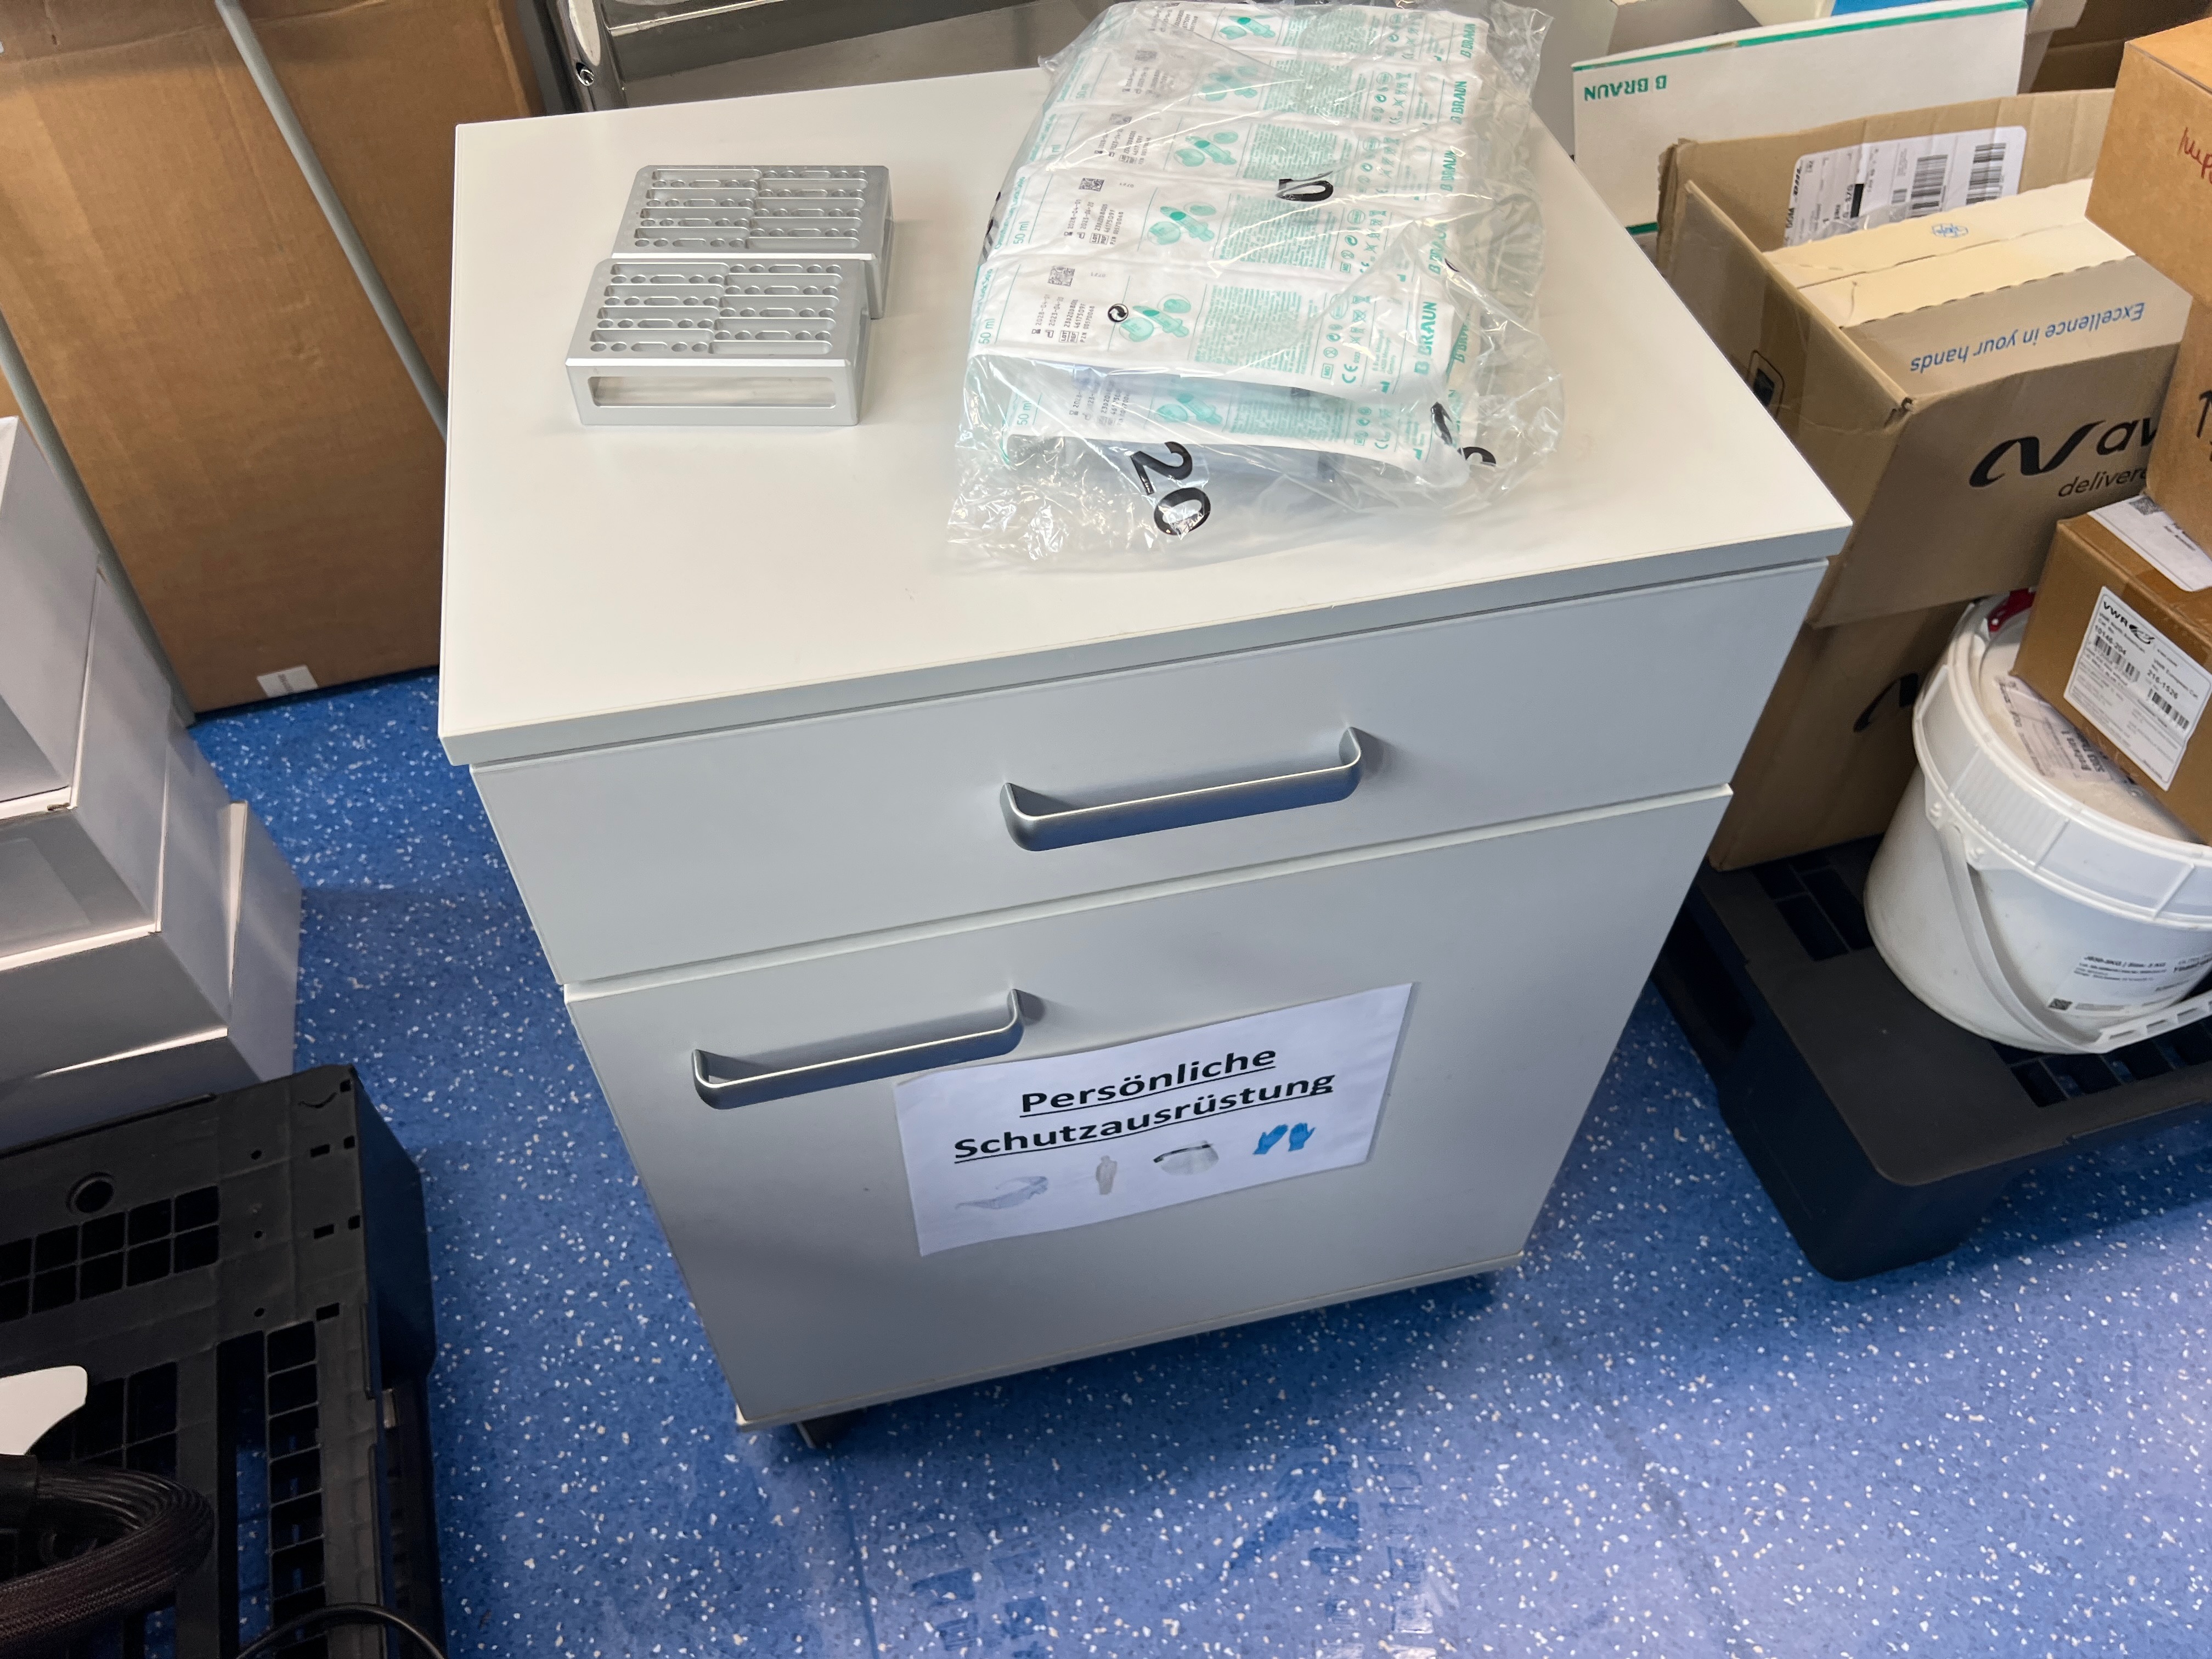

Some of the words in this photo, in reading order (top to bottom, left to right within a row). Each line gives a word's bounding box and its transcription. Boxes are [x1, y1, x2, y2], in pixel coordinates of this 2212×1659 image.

[1460, 50, 1472, 59] B
[1584, 78, 1649, 101] BRAUN
[1656, 75, 1667, 89] B
[1451, 81, 1467, 115] BRAUN
[1013, 233, 1025, 245] 50
[1019, 221, 1030, 232] ml
[1429, 264, 1441, 274] B
[979, 332, 992, 344] 50
[987, 318, 996, 330] ml
[1418, 302, 1437, 356] BRAUN
[2045, 302, 2145, 338] Excellence
[1974, 330, 2018, 356] your
[2023, 328, 2040, 346] in
[1414, 361, 1430, 375] B
[1910, 346, 1970, 373] hands
[1017, 414, 1029, 425] 50
[1130, 441, 1211, 535] 20
[2103, 601, 2128, 627] VWR
[1021, 1049, 1277, 1114] Persönliche
[955, 1074, 1336, 1159] Schutzausrüstung
